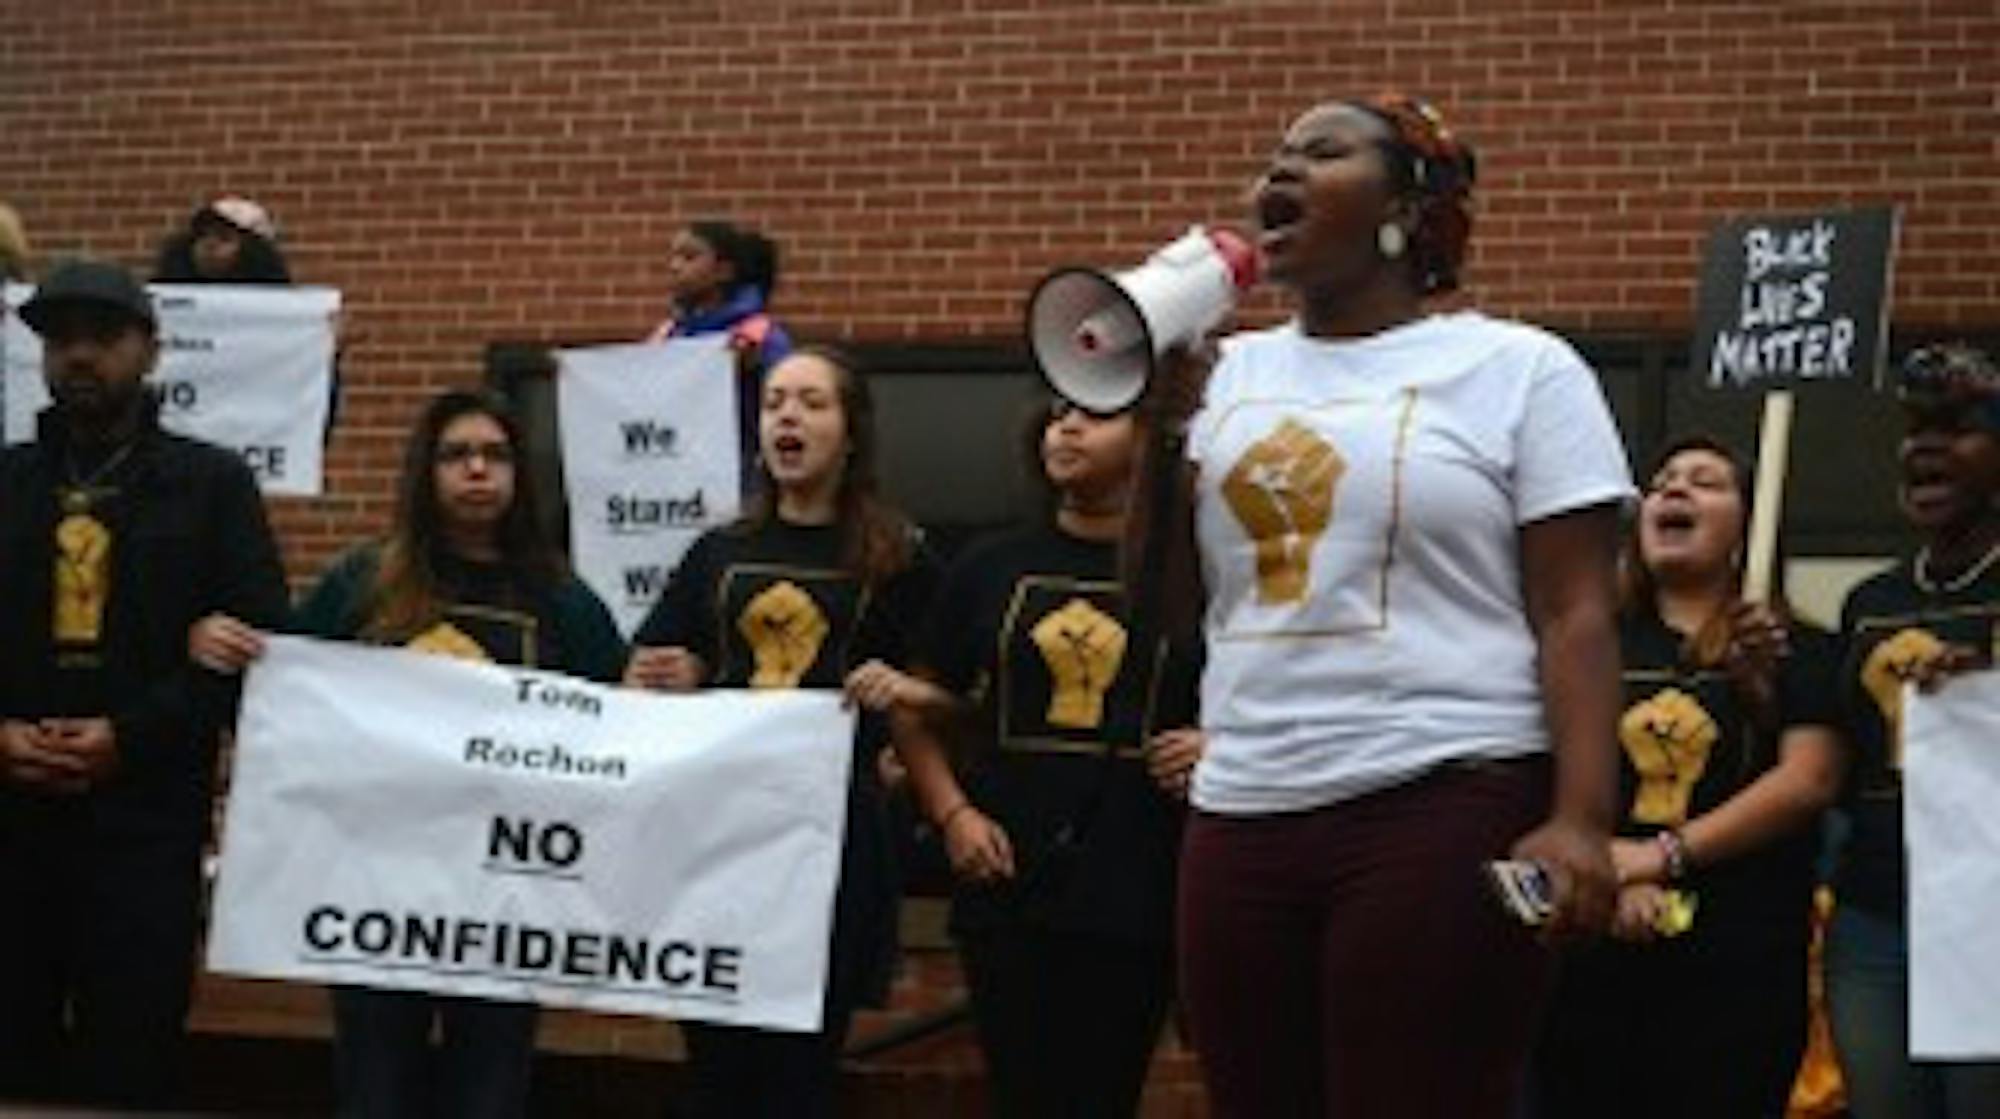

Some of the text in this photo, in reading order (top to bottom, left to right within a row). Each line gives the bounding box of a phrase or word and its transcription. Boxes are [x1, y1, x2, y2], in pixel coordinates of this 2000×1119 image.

[1707, 318, 1857, 388] MATTER
[620, 419, 677, 452] We
[606, 488, 705, 526] Stand
[514, 677, 603, 718] Tom
[463, 737, 627, 780] Rochon
[488, 815, 585, 870] NO
[303, 905, 745, 995] CONFIDENCE
